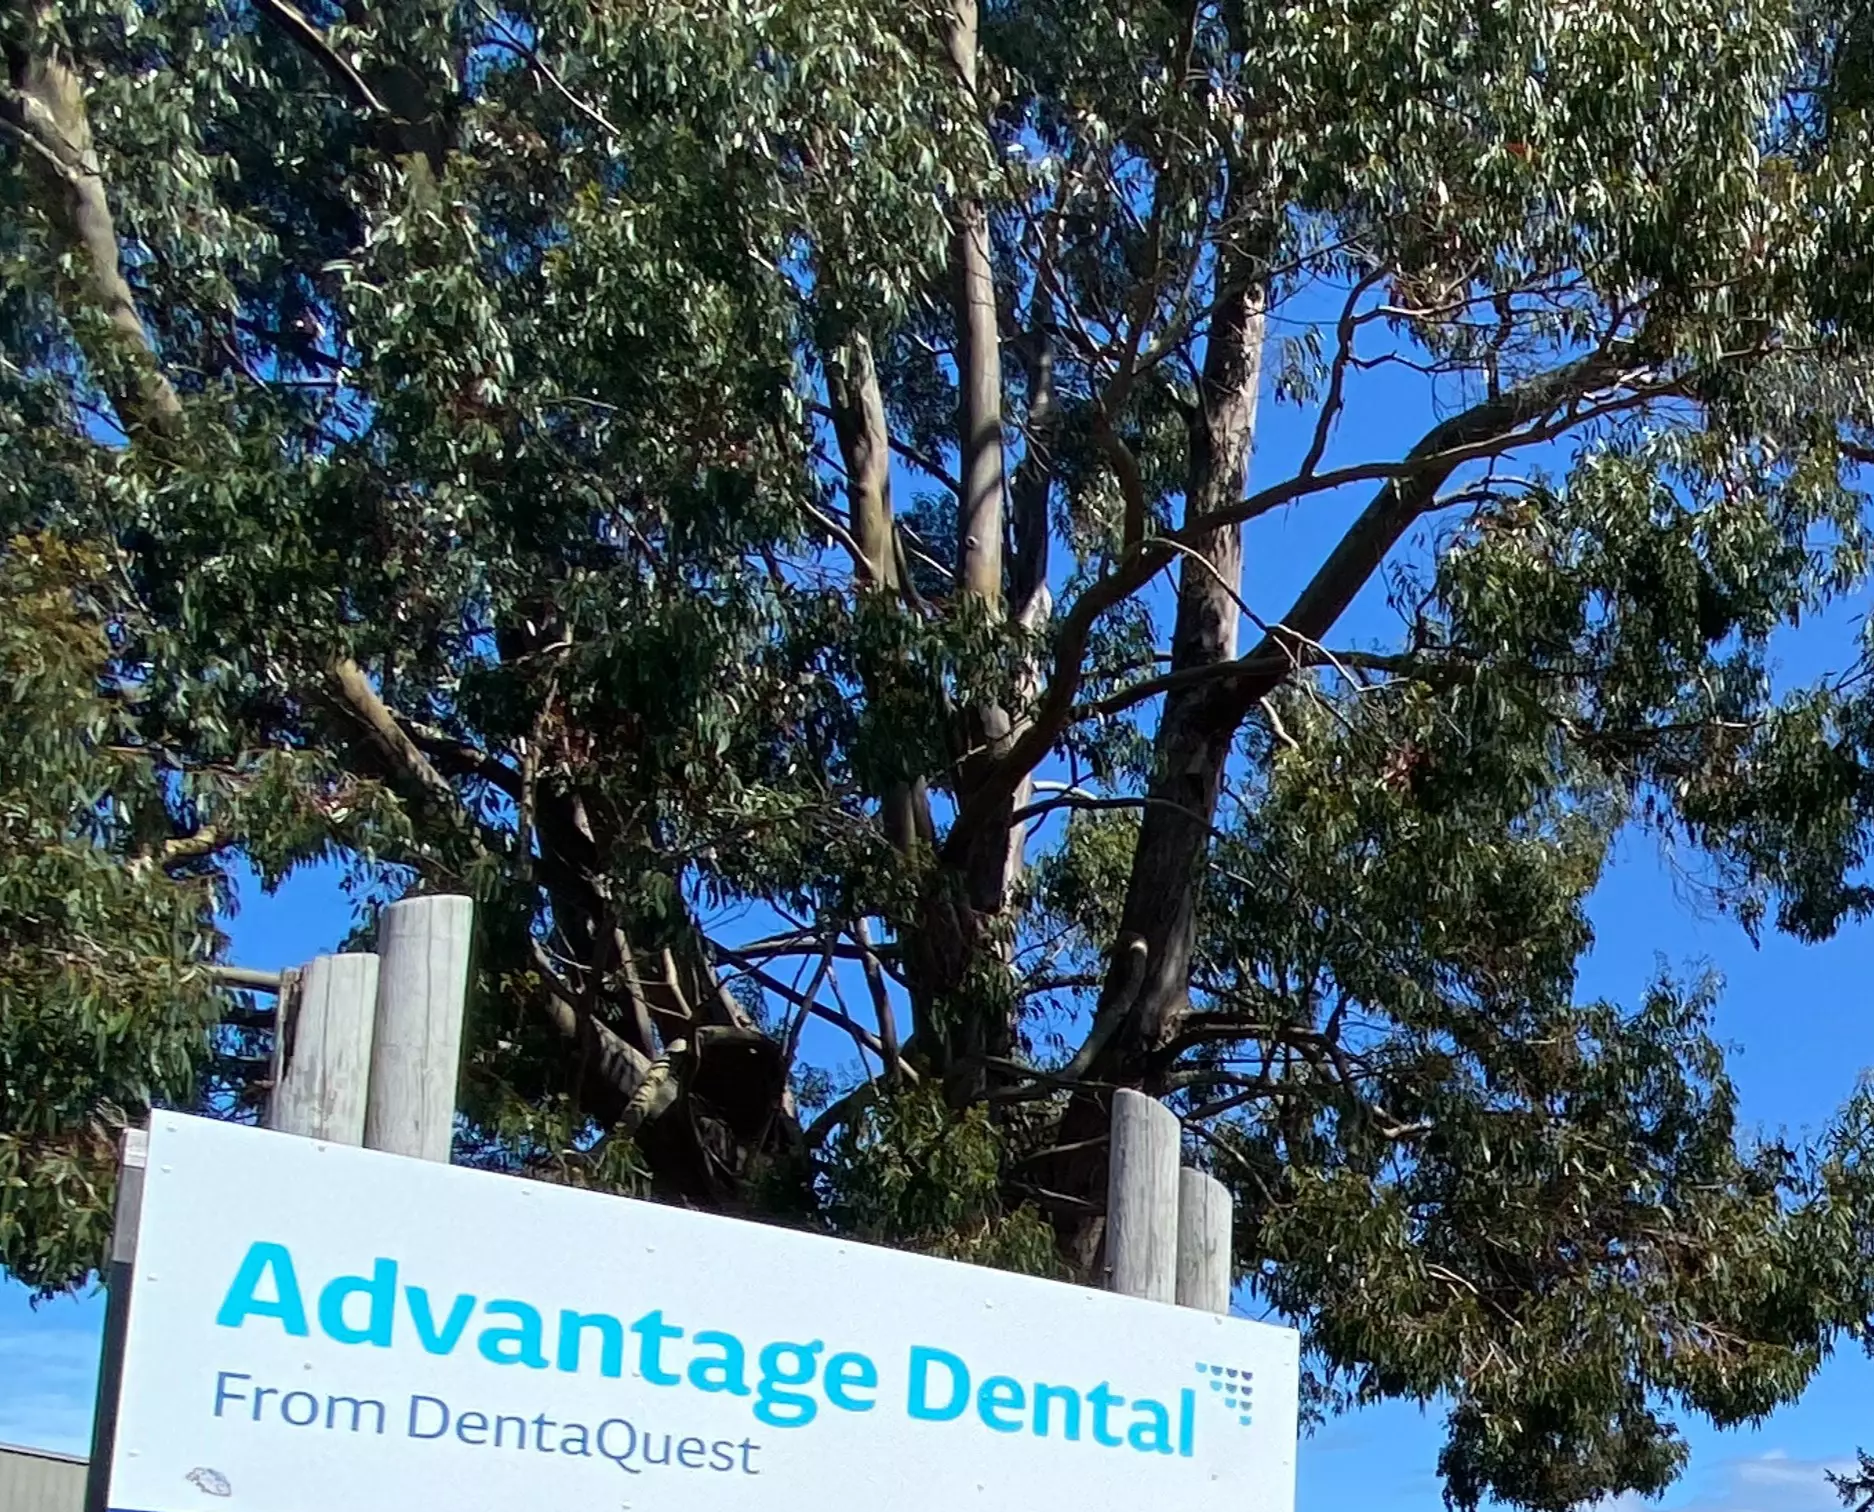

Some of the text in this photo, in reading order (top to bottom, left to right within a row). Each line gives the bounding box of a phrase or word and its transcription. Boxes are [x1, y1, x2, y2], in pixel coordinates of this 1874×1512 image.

[214, 1371, 761, 1475] From DentaQuest
[215, 1240, 1196, 1457] Advantage Dental
